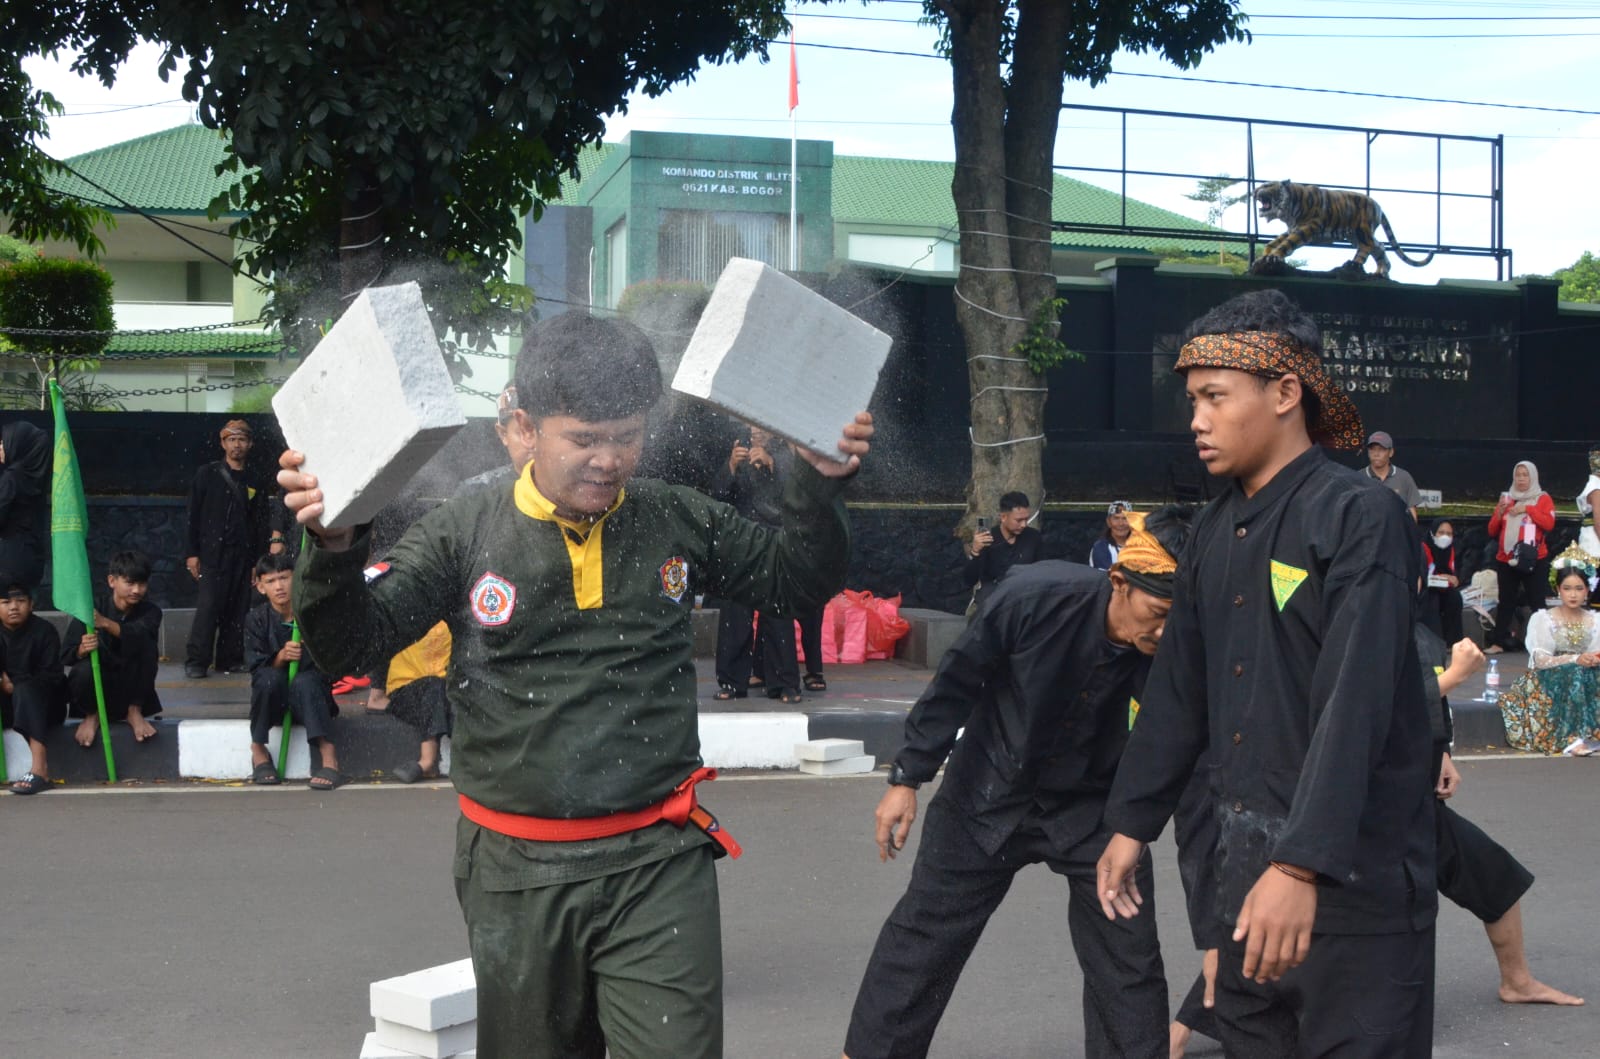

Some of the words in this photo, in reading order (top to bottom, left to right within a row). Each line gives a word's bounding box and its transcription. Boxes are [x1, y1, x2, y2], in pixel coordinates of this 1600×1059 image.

[662, 167, 716, 178] KOMANDO
[717, 169, 758, 181] DISTRIK
[682, 183, 708, 193] 0621
[711, 184, 738, 194] KAB.
[742, 186, 783, 196] BOGOR
